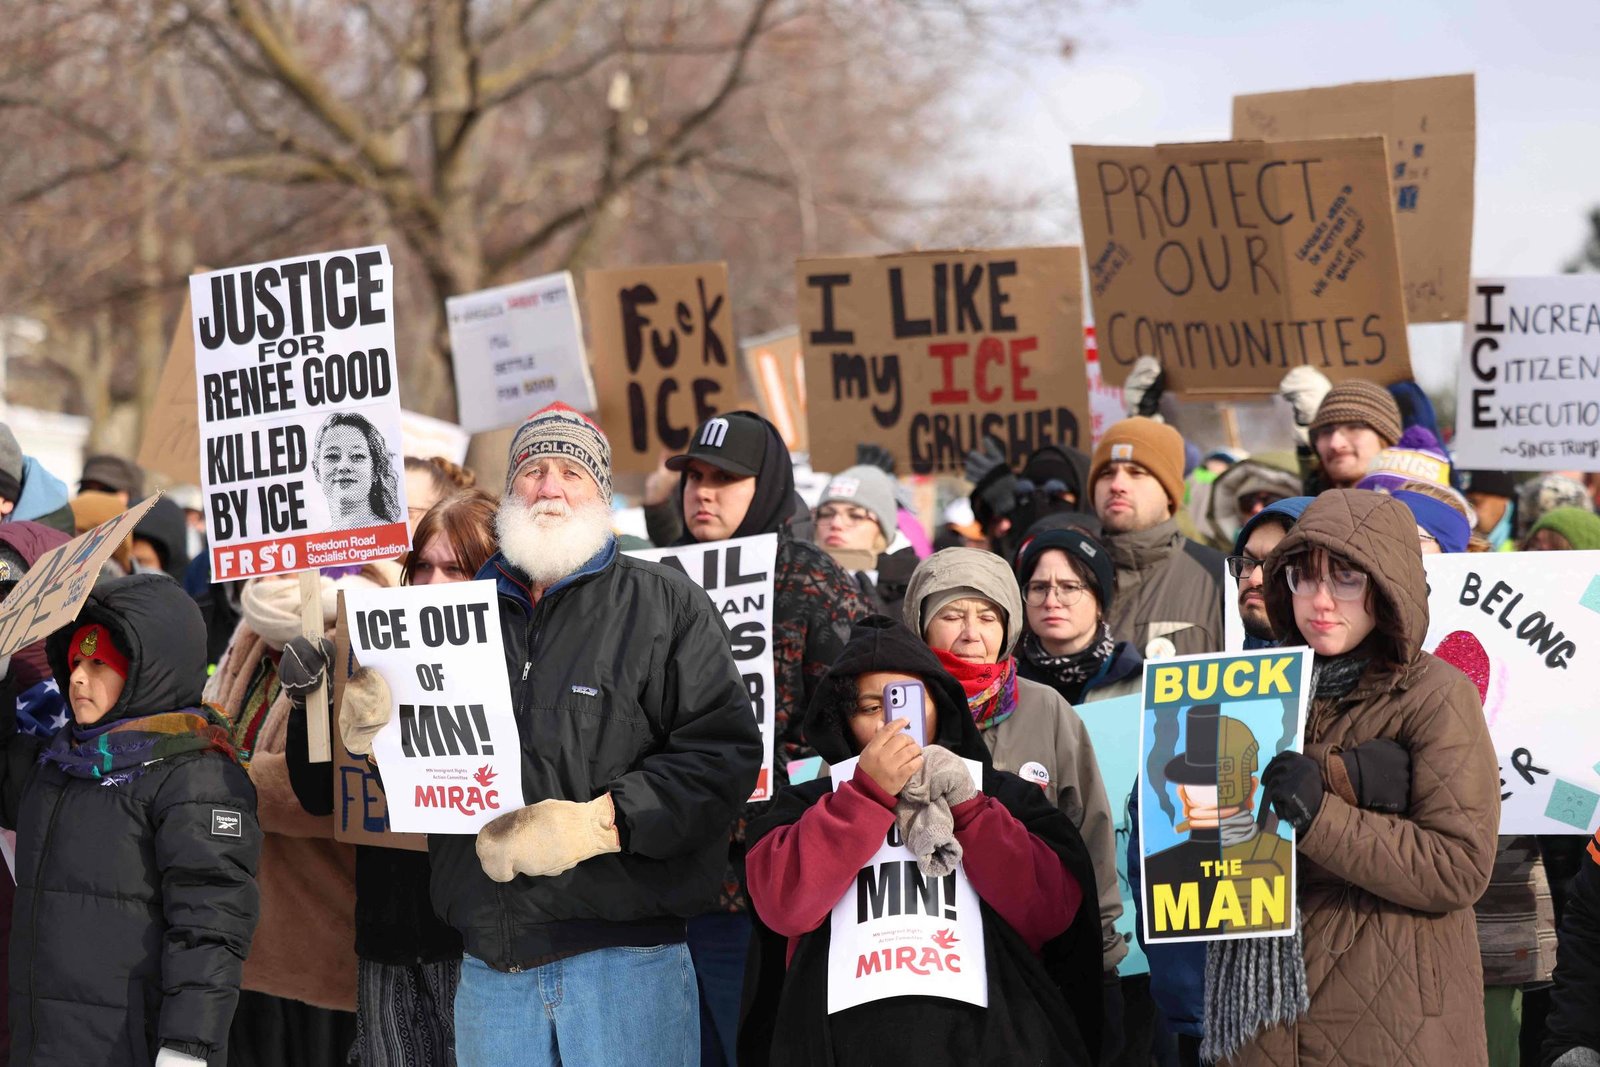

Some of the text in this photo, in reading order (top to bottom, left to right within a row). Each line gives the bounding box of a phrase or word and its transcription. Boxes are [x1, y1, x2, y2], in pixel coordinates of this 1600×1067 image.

[1098, 159, 1322, 240] PROTECT
[1155, 234, 1281, 297] OUR
[199, 250, 386, 350] JUSTICE
[807, 273, 855, 346] I
[888, 260, 1018, 340] LIKE
[258, 335, 325, 363] FOR
[928, 337, 1039, 405] ICE
[1107, 313, 1387, 370] COMMUNITIES
[203, 347, 392, 423] RENEE GOOD
[628, 377, 721, 454] ICE
[206, 424, 308, 486] KILLED
[908, 406, 1080, 475] CRUSHED
[210, 481, 308, 541] BY ICE
[306, 534, 376, 553] Freedom Road
[307, 543, 406, 565] Socialist Organization
[355, 602, 489, 651] ICE OUT
[1458, 571, 1577, 670] BELONG
[415, 663, 445, 692] OF
[1153, 656, 1296, 704] BUCK
[399, 704, 495, 758] MN!
[216, 815, 239, 823] Reebok
[339, 766, 391, 833] FE
[857, 861, 958, 925] MN!
[1200, 859, 1243, 878] THE
[1152, 875, 1286, 932] MAN
